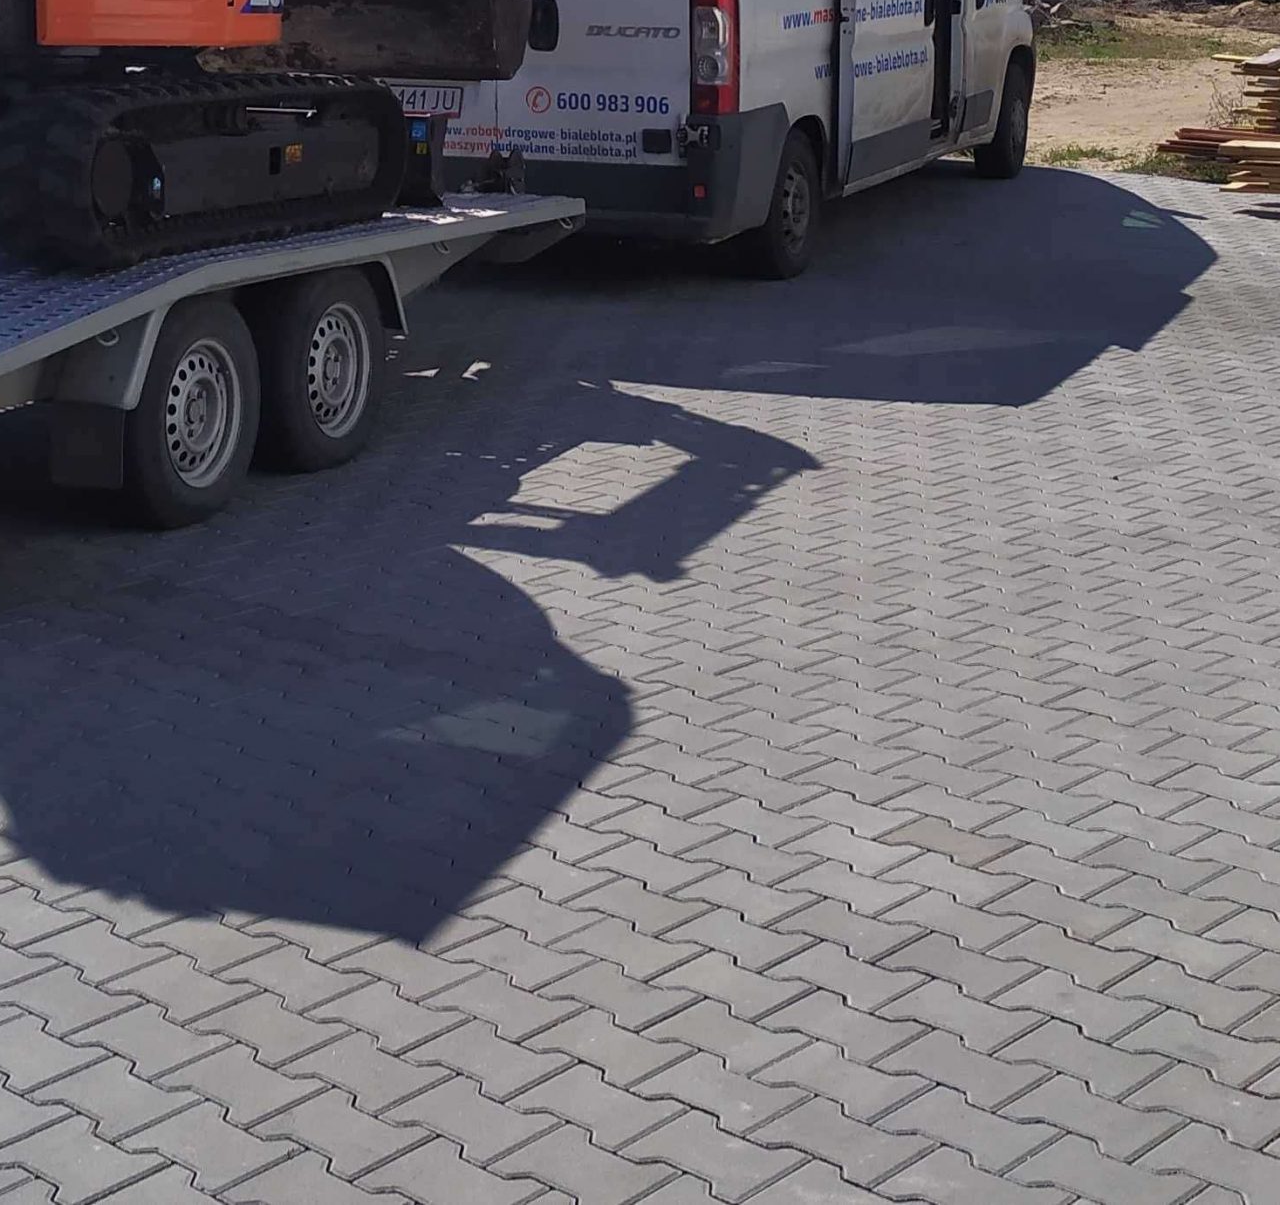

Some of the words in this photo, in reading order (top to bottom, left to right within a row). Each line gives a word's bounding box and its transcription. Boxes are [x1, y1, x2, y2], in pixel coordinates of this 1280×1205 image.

[585, 25, 681, 40] DUCATO
[556, 93, 591, 111] 600
[596, 94, 630, 113] 983
[635, 95, 670, 115] 906
